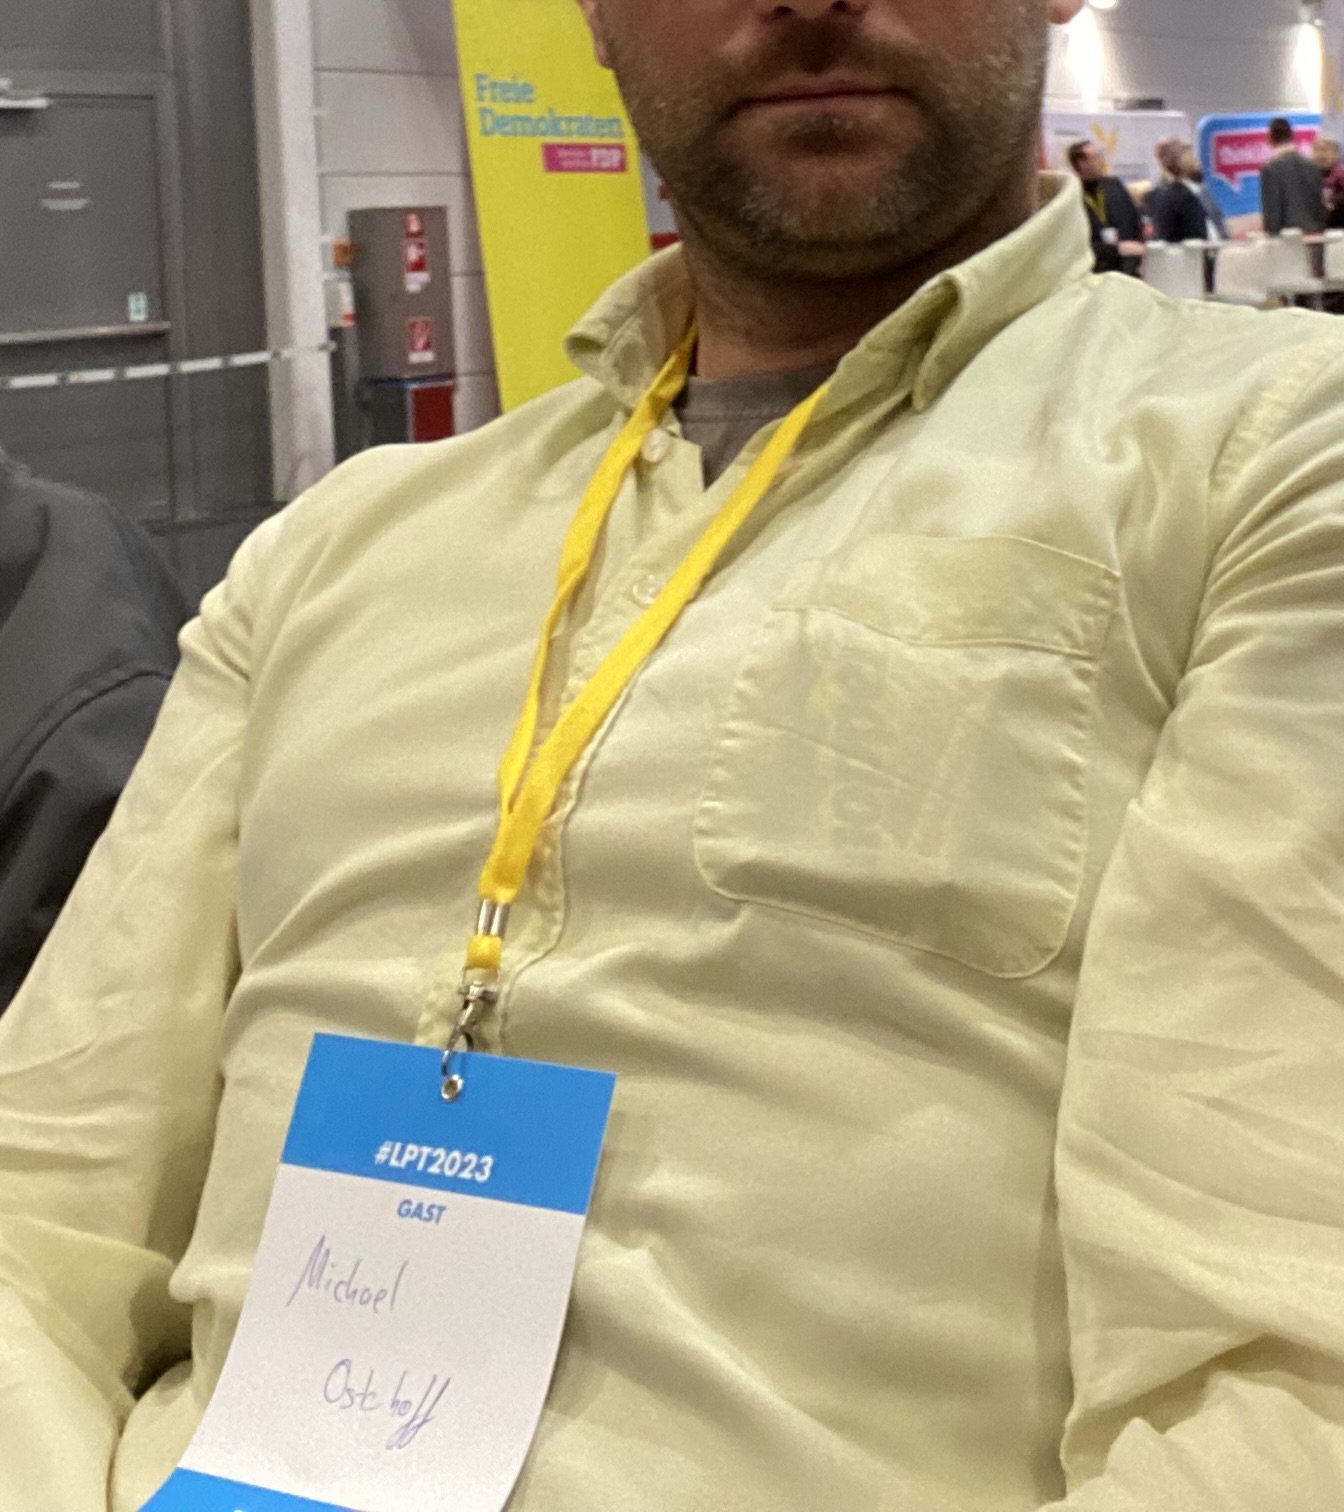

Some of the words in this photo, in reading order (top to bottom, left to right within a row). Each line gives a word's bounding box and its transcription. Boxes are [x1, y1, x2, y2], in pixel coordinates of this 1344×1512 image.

[474, 73, 536, 103] Freie
[478, 107, 625, 138] Demokraten
[374, 1140, 494, 1183] #LPT2023
[397, 1198, 447, 1225] GAST
